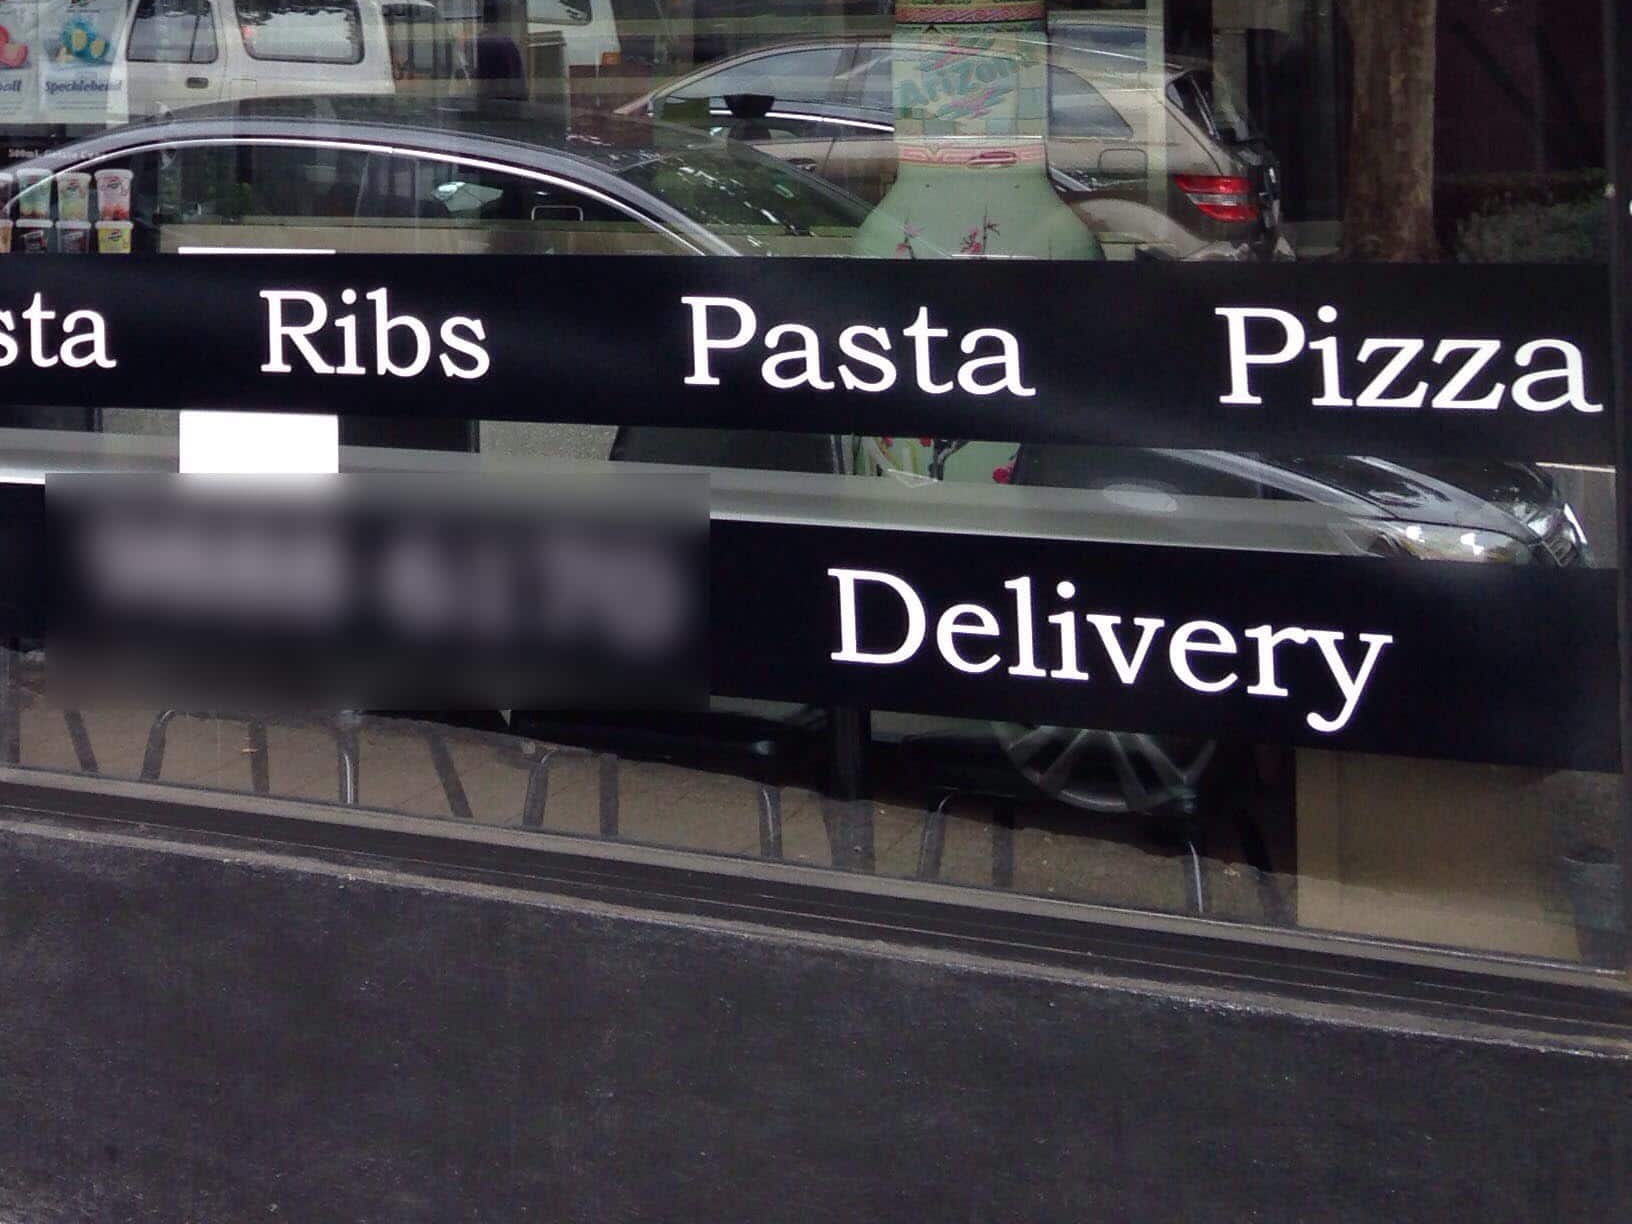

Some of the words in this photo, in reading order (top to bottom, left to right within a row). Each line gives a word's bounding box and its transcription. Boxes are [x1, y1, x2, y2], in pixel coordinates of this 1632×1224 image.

[258, 288, 492, 380] Ribs
[680, 294, 1037, 398] Pasta
[1214, 304, 1604, 414] Pizza
[827, 566, 1394, 735] Delivery
